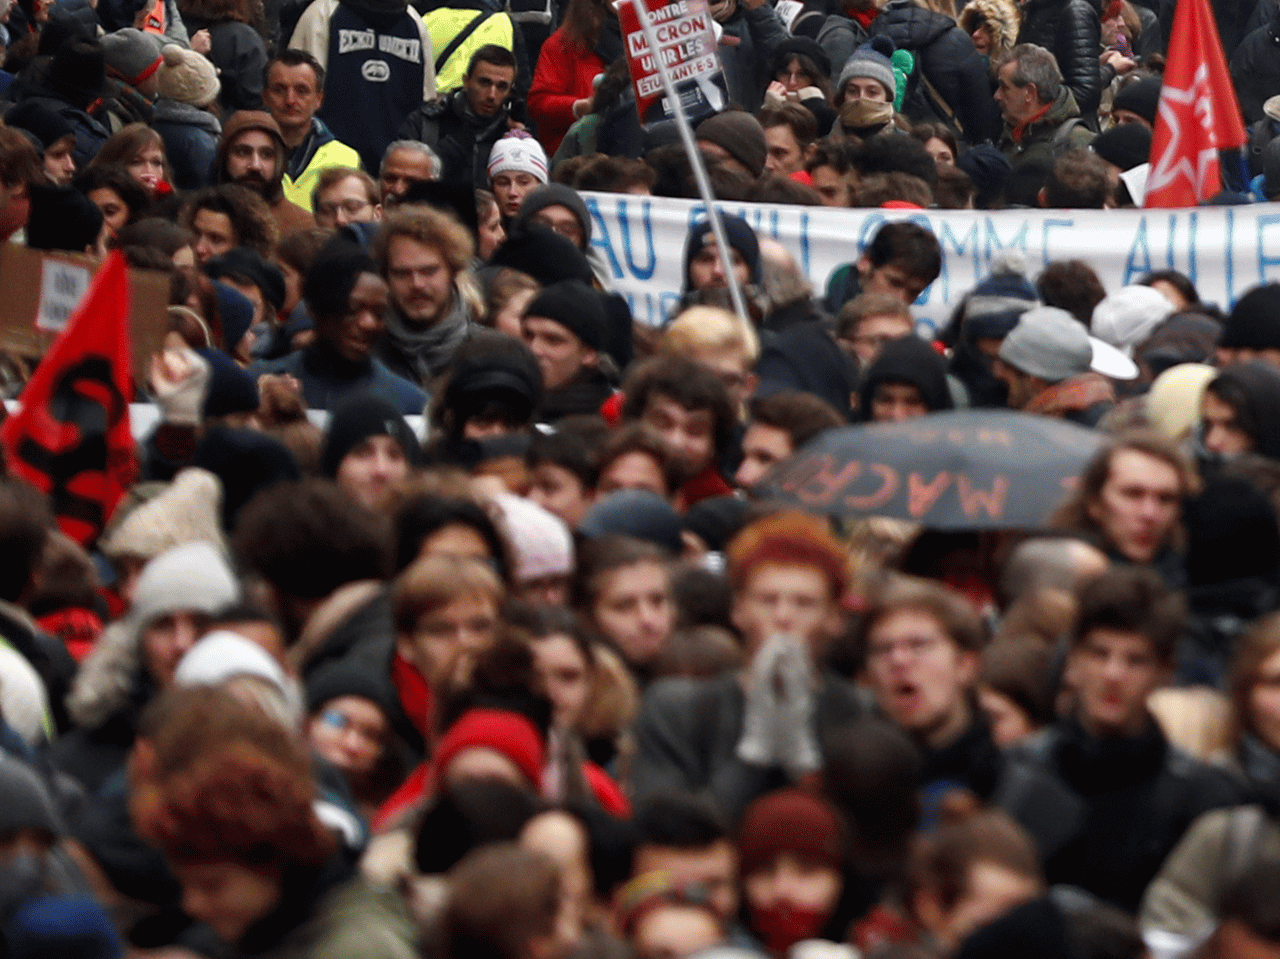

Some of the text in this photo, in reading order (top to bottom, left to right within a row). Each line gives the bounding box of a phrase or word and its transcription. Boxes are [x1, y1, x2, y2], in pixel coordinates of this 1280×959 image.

[648, 0, 689, 24] ONTRE
[632, 15, 706, 52] MCRON
[678, 39, 704, 60] LES
[586, 197, 657, 280] AU
